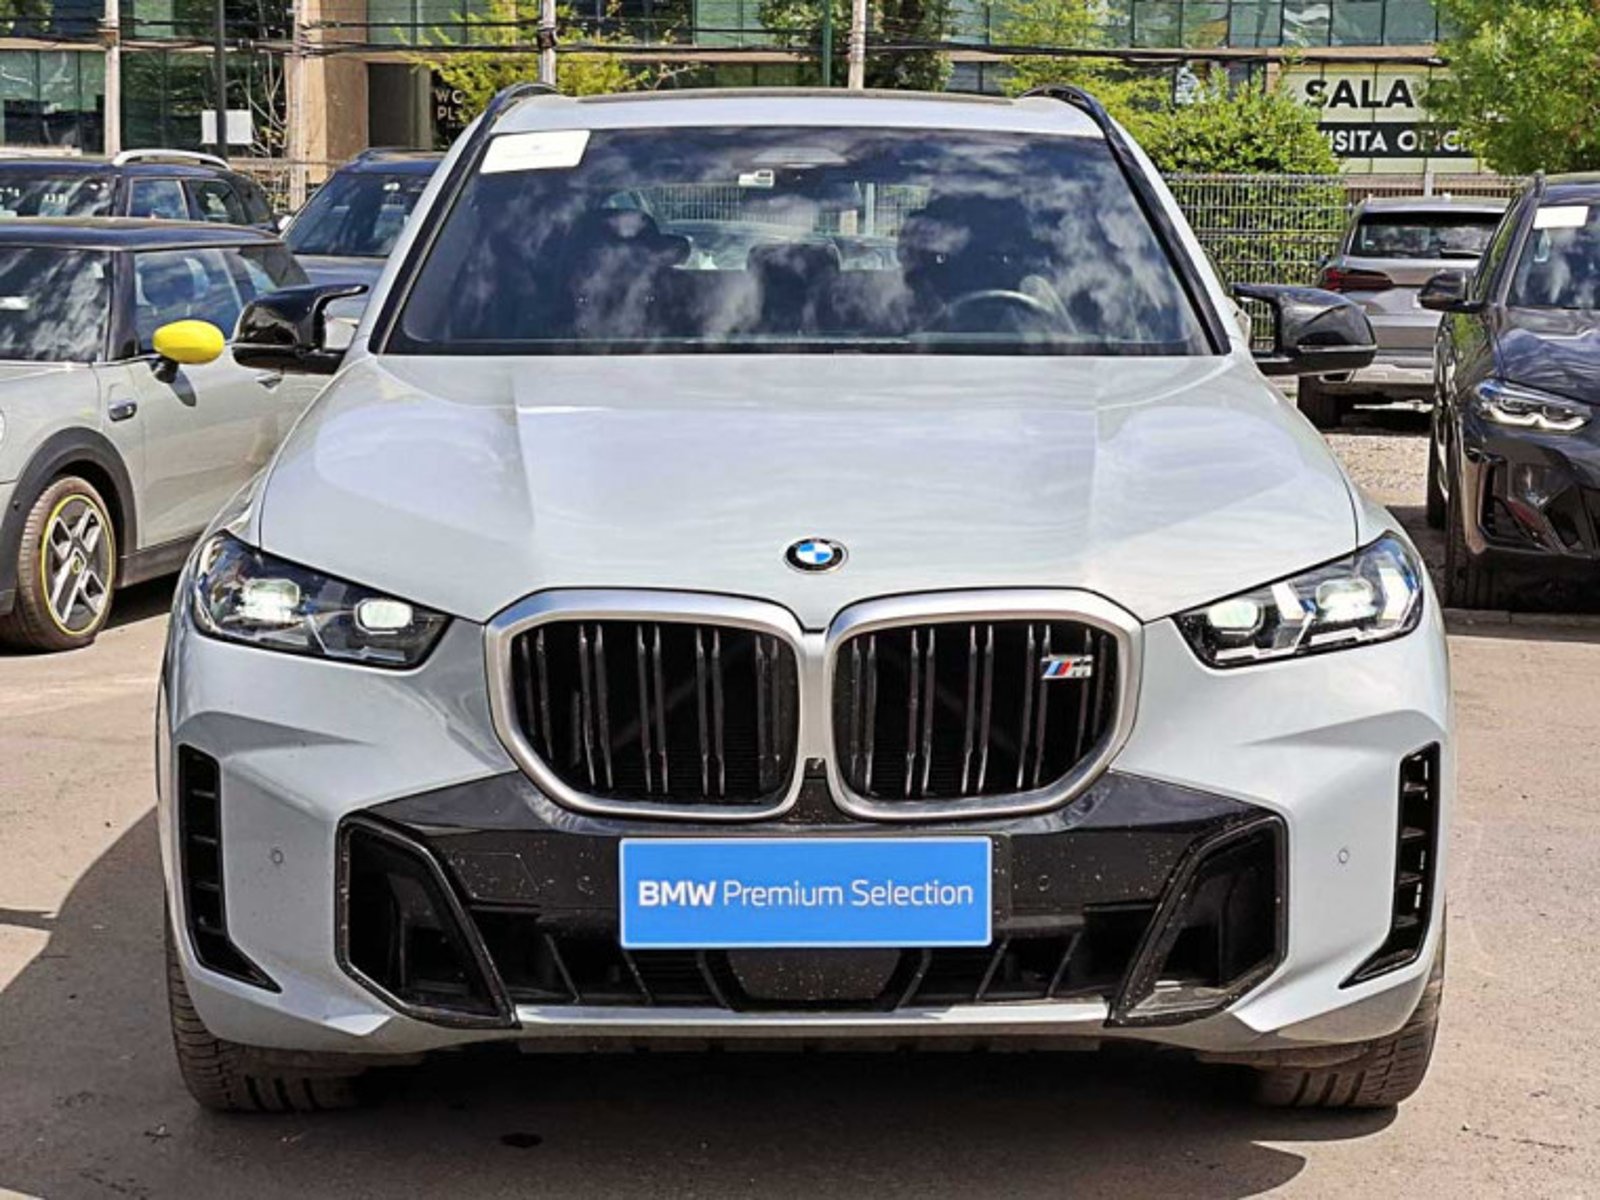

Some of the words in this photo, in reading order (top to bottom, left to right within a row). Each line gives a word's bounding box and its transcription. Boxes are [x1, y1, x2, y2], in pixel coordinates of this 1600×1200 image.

[1305, 79, 1414, 108] SALA
[638, 880, 716, 906] BMW
[723, 880, 843, 906] Premium
[851, 879, 973, 906] Selection
